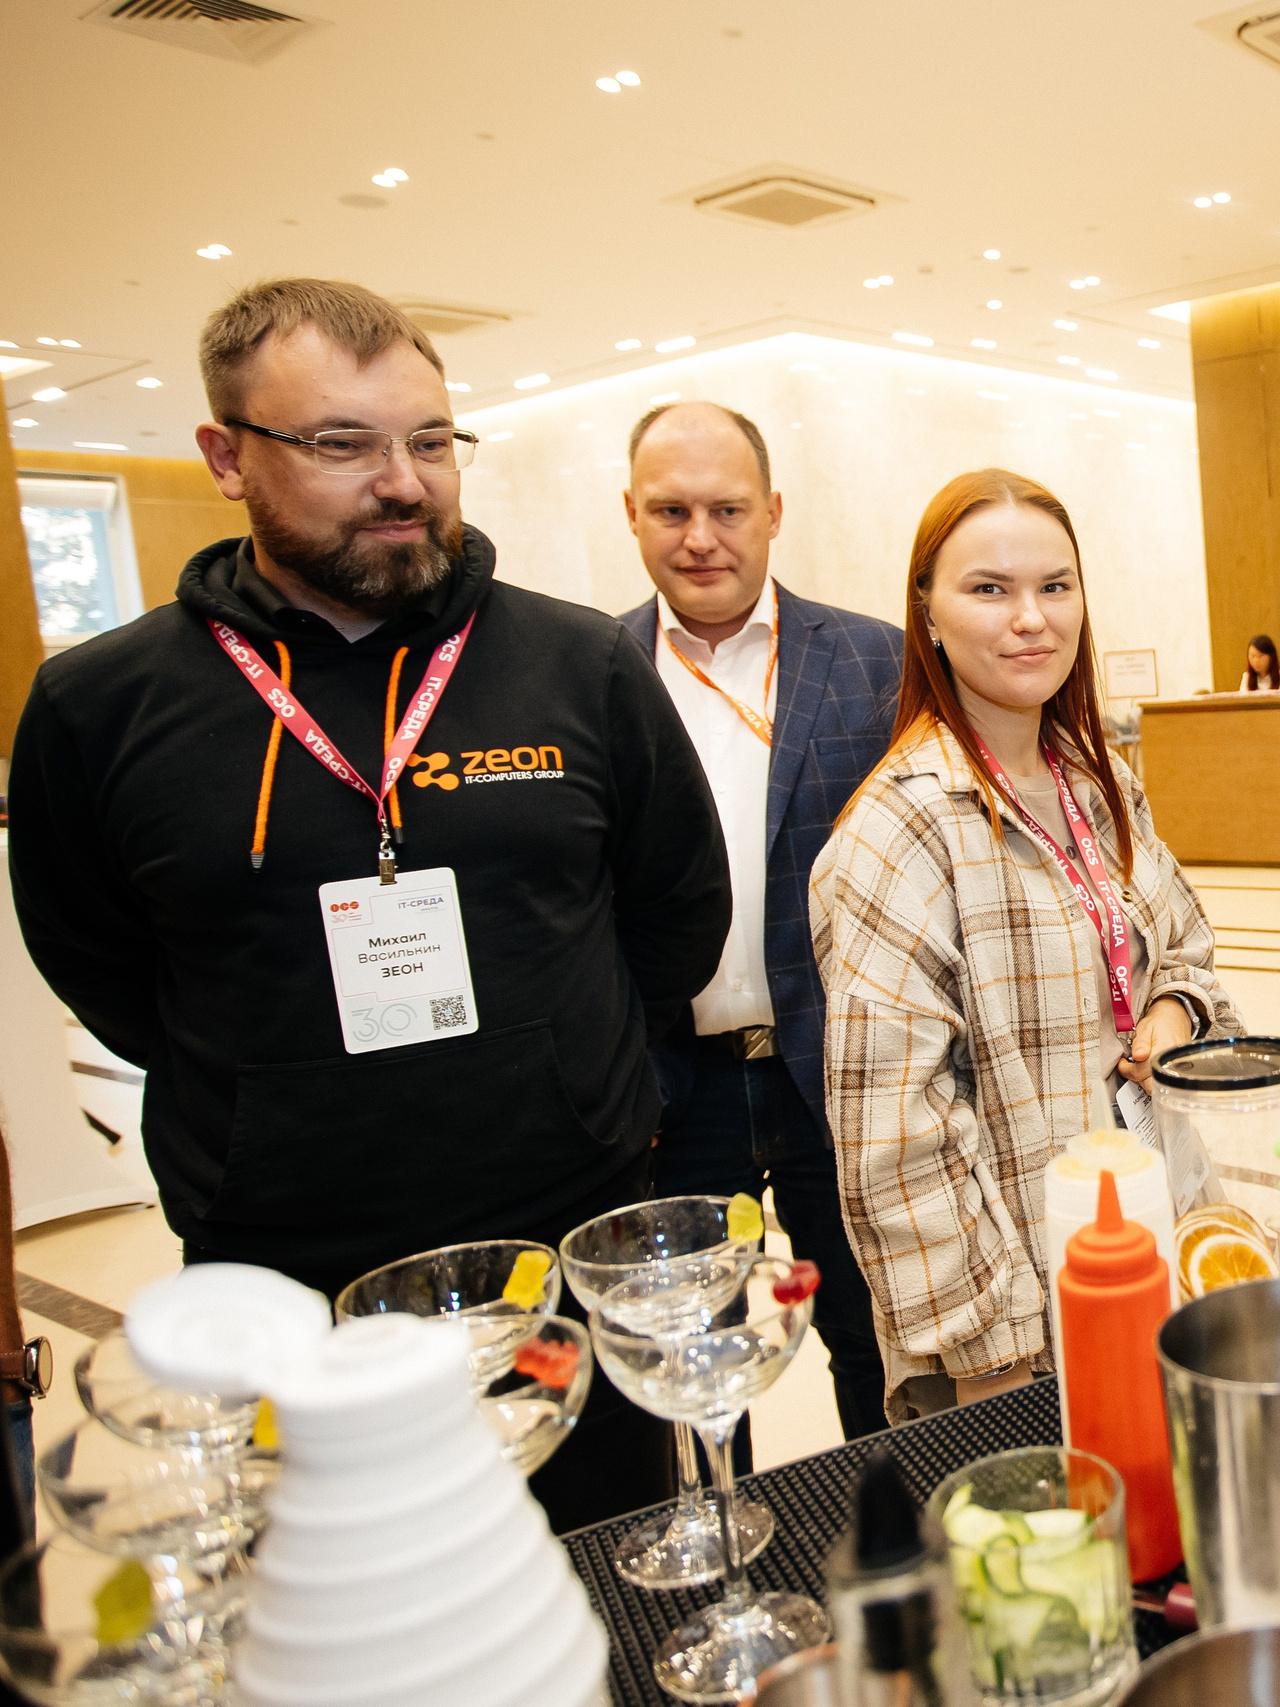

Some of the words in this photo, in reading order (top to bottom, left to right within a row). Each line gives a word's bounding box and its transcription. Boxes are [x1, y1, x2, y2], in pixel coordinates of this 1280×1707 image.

[267, 688, 296, 718] OCS
[400, 676, 443, 740] IT-СРЕДА
[460, 746, 563, 775] zeon
[465, 771, 533, 785] IT-COMPUTERS
[533, 770, 565, 780] GROUP
[1052, 762, 1081, 823] IT-СРЕДА
[1081, 837, 1099, 866] OCS
[398, 897, 444, 910] IT-СРЕДА
[1074, 883, 1095, 912] OCS
[1098, 880, 1125, 948] IT-СРЕДА
[358, 944, 441, 964] Василькин
[368, 932, 427, 949] Михаил
[381, 962, 424, 978] ЗЕОН
[351, 1003, 418, 1042] 30
